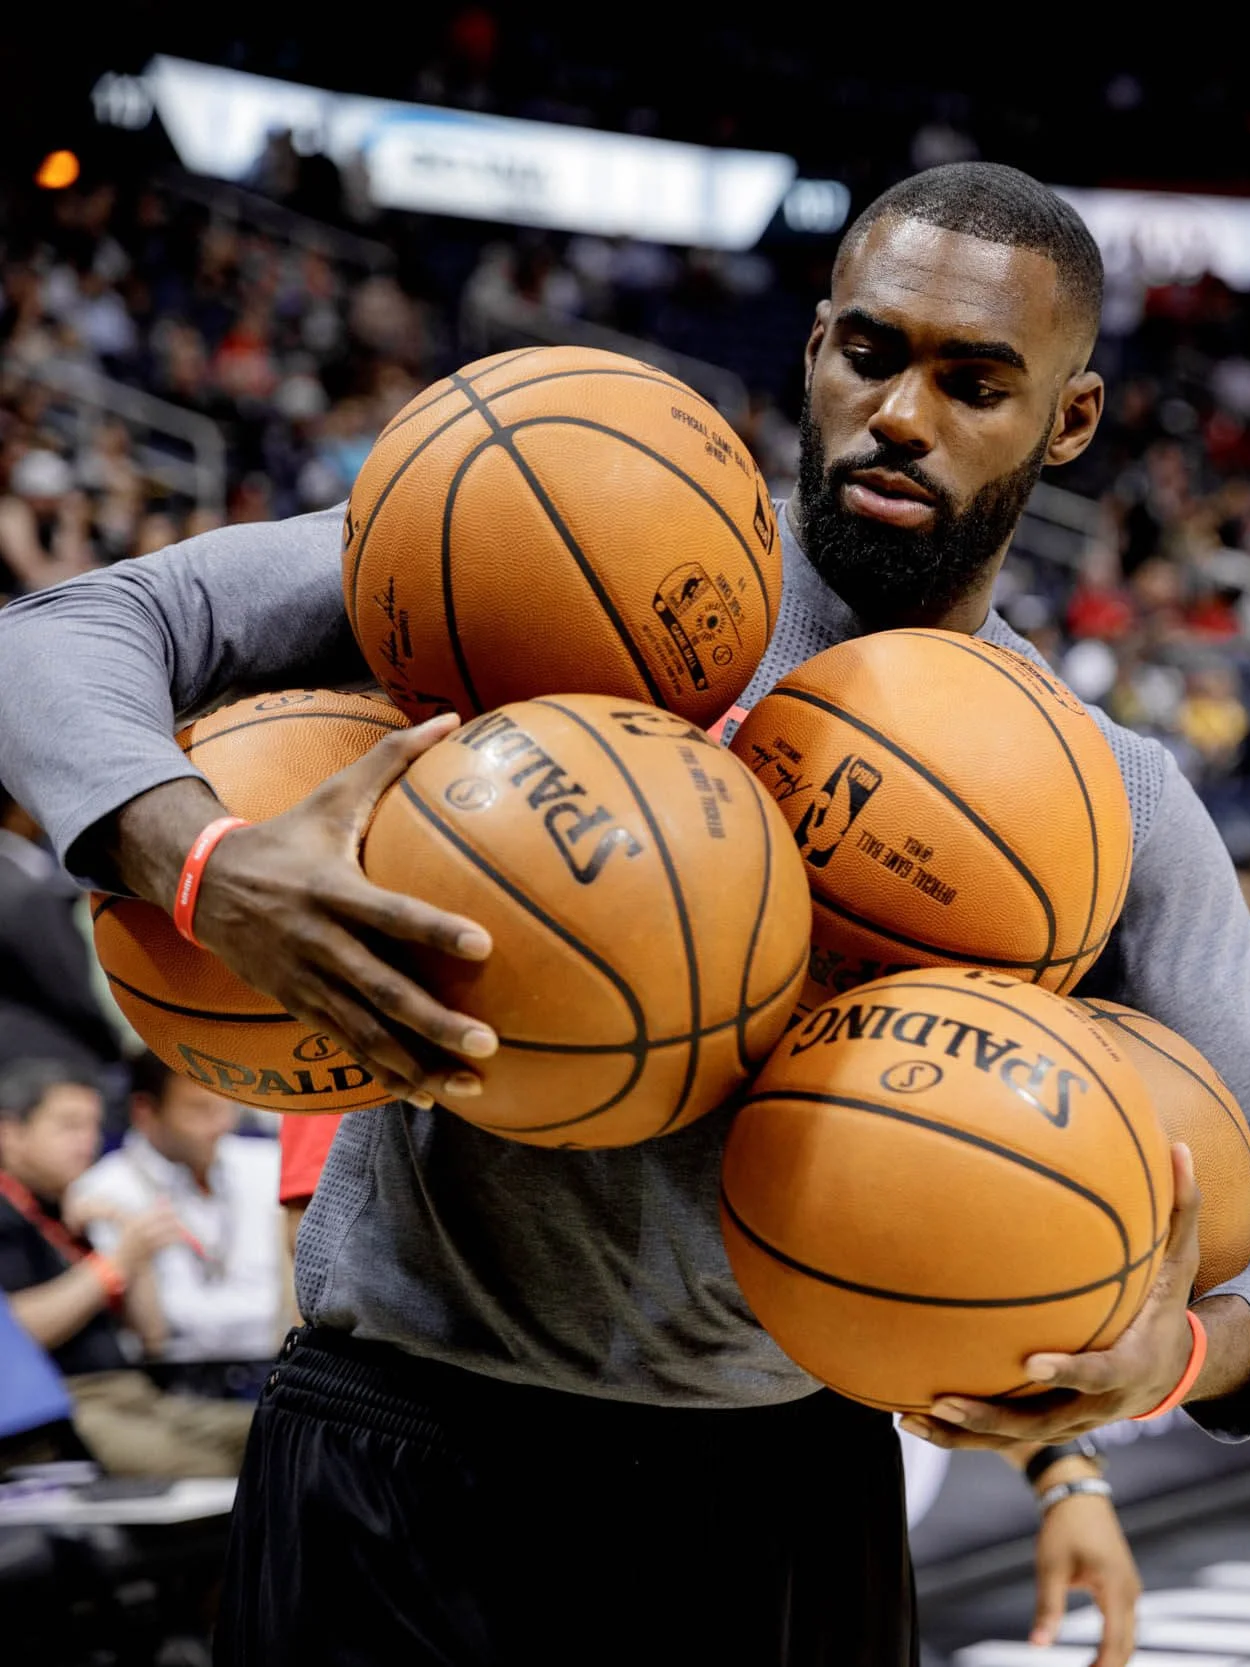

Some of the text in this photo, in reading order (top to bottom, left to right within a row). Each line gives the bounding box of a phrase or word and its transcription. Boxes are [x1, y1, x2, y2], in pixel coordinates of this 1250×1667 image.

[671, 406, 709, 439] OFFICIAL
[448, 713, 642, 884] SPALDIN
[850, 763, 879, 791] NBA
[856, 829, 957, 906] OFFICIAL GAME BALL
[903, 836, 933, 863] @NBA
[177, 1042, 374, 1096] SPALD
[790, 1004, 1089, 1129] SPALDING
